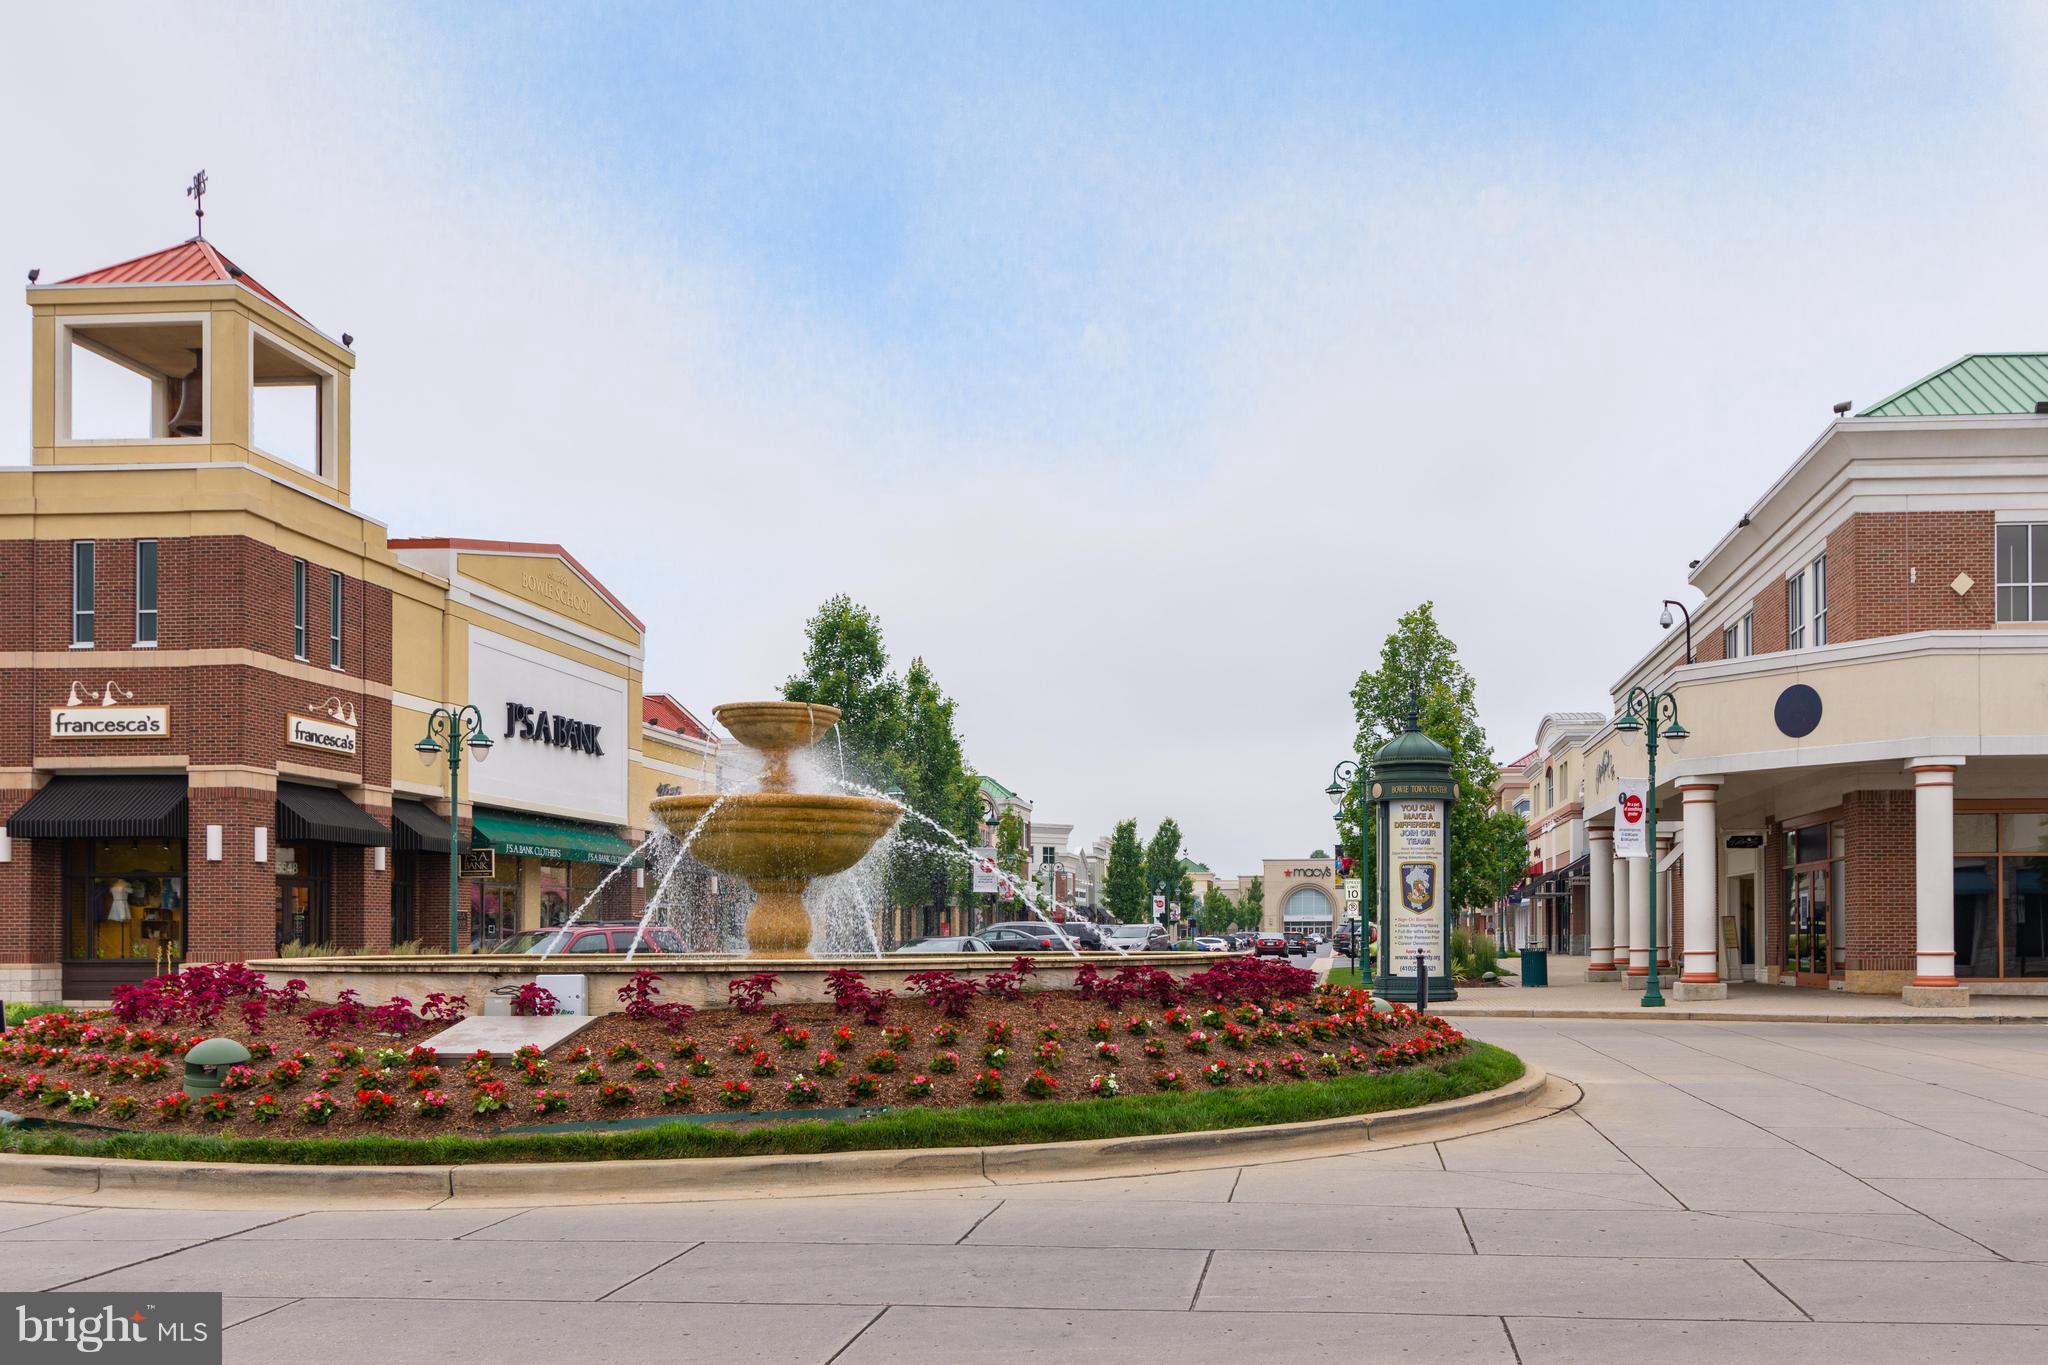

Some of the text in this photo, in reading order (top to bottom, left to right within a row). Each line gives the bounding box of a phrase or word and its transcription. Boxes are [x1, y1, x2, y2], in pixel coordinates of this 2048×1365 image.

[521, 572, 553, 599] BOWIE
[554, 585, 591, 616] SCHOOL
[56, 713, 160, 733] francesca's
[295, 721, 354, 750] francesca's
[1392, 784, 1448, 794] BOWIE TOWN CENTER
[1293, 866, 1332, 879] macy's
[1348, 890, 1358, 898] 10
